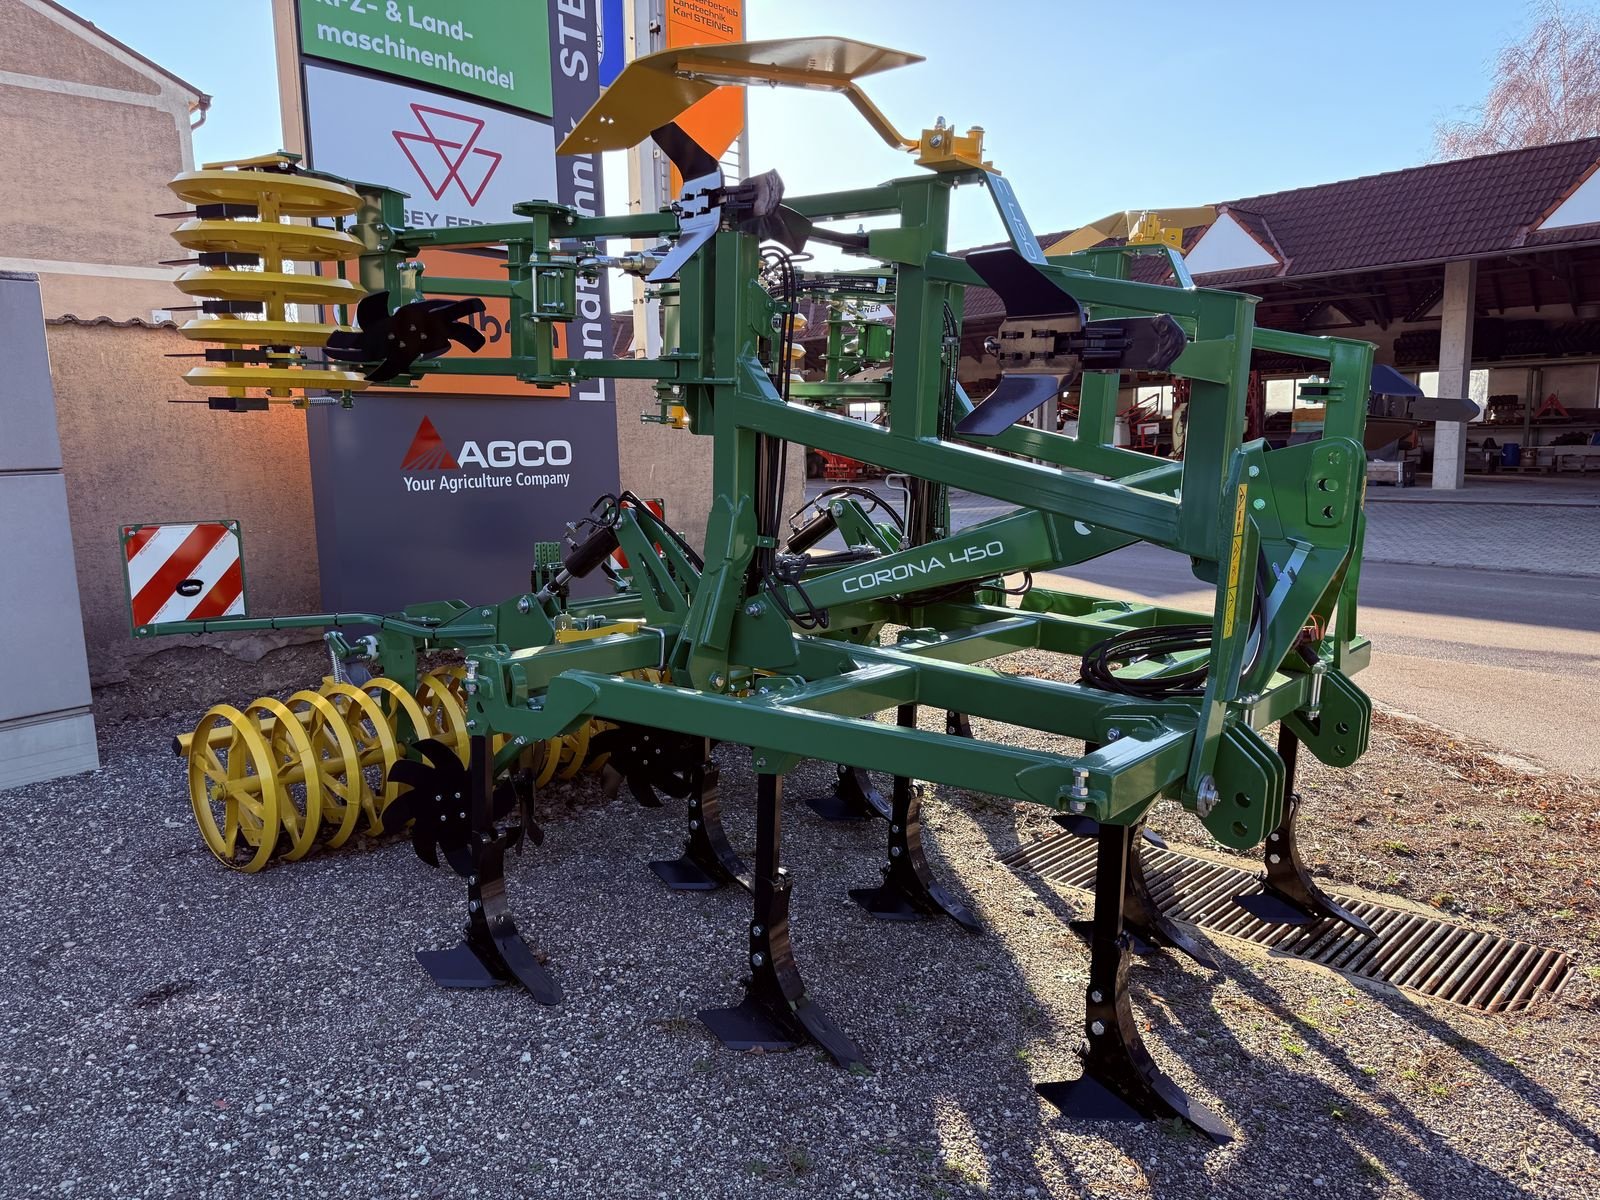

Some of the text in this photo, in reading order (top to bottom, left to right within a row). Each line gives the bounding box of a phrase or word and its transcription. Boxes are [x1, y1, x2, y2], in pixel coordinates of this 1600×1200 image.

[385, 0, 402, 23] &
[408, 5, 474, 41] Land-
[673, 6, 734, 35] Karl STEINER
[317, 23, 515, 91] maschinenhandel
[1008, 202, 1037, 260] 450
[457, 440, 573, 469] AGCO
[403, 472, 570, 494] Your Agriculture Company
[842, 541, 1004, 593] CORONA 450
